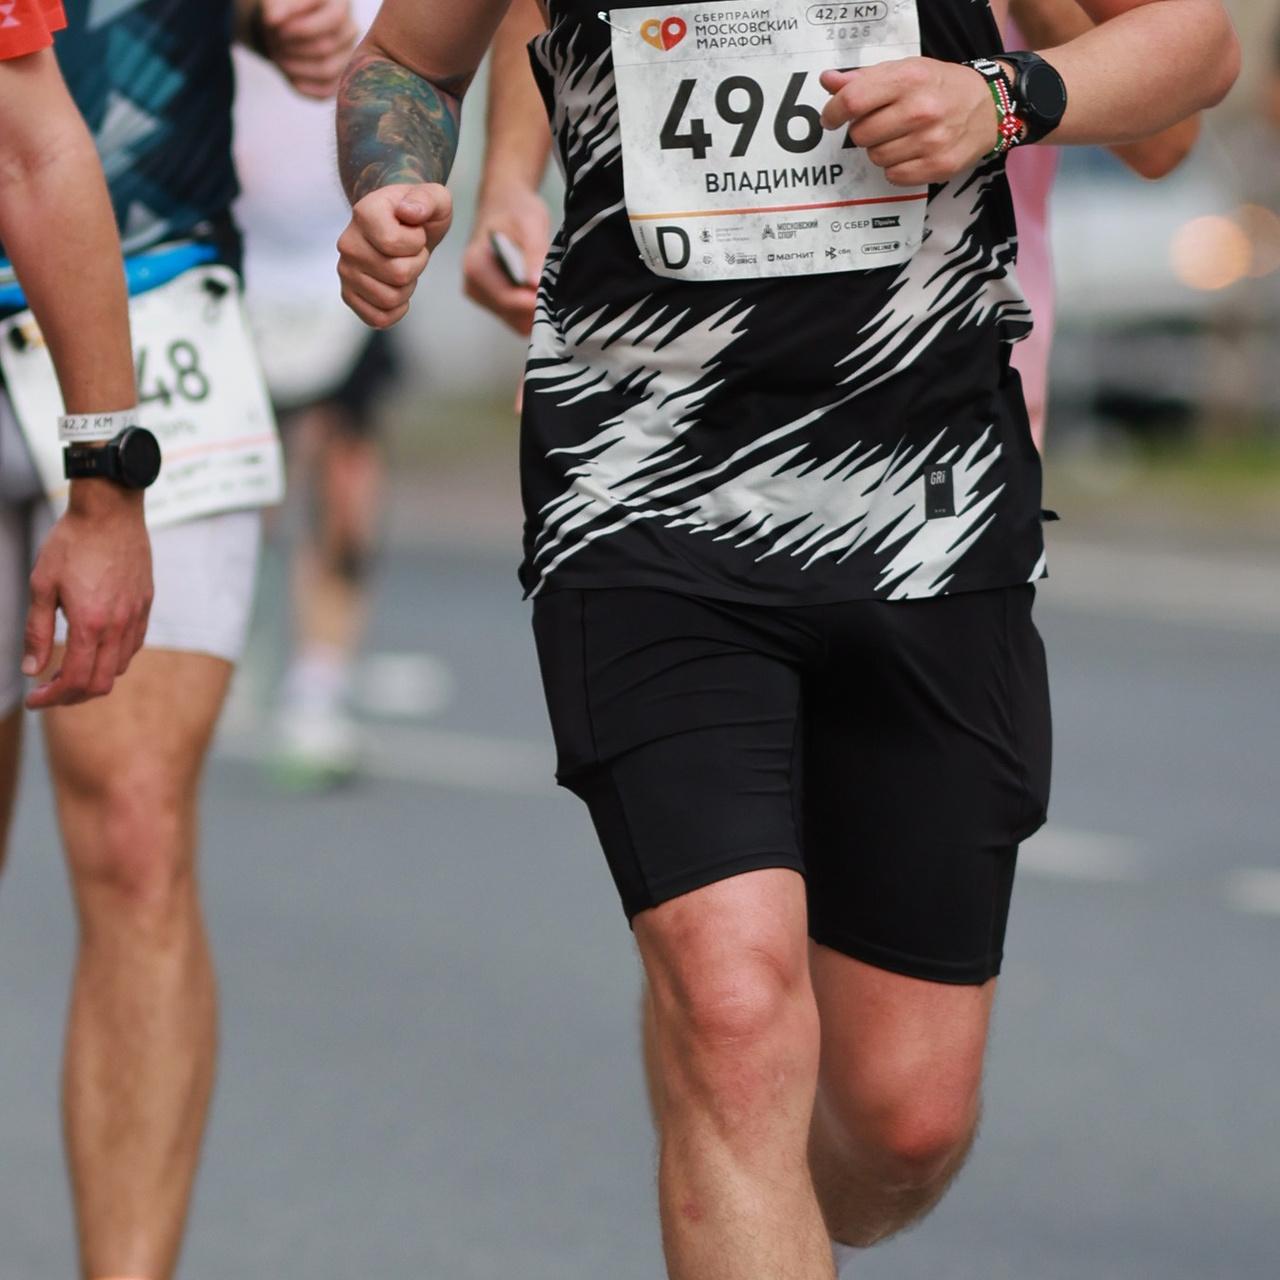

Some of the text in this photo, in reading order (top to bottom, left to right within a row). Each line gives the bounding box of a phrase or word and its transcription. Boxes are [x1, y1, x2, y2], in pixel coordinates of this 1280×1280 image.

[694, 9, 770, 23] СБЕРПРАЙМ
[815, 7, 848, 21] 42,2
[695, 17, 798, 37] МОСКОВСКИЙ
[696, 35, 772, 50] МАРАФОН
[659, 67, 863, 159] 496
[705, 164, 843, 195] ВЛАДИМИР
[776, 219, 819, 231] МОСКОВСКИЙ
[844, 220, 870, 230] СБЕР
[656, 225, 690, 270] D
[138, 339, 210, 408] 48
[63, 418, 88, 431] 42,2
